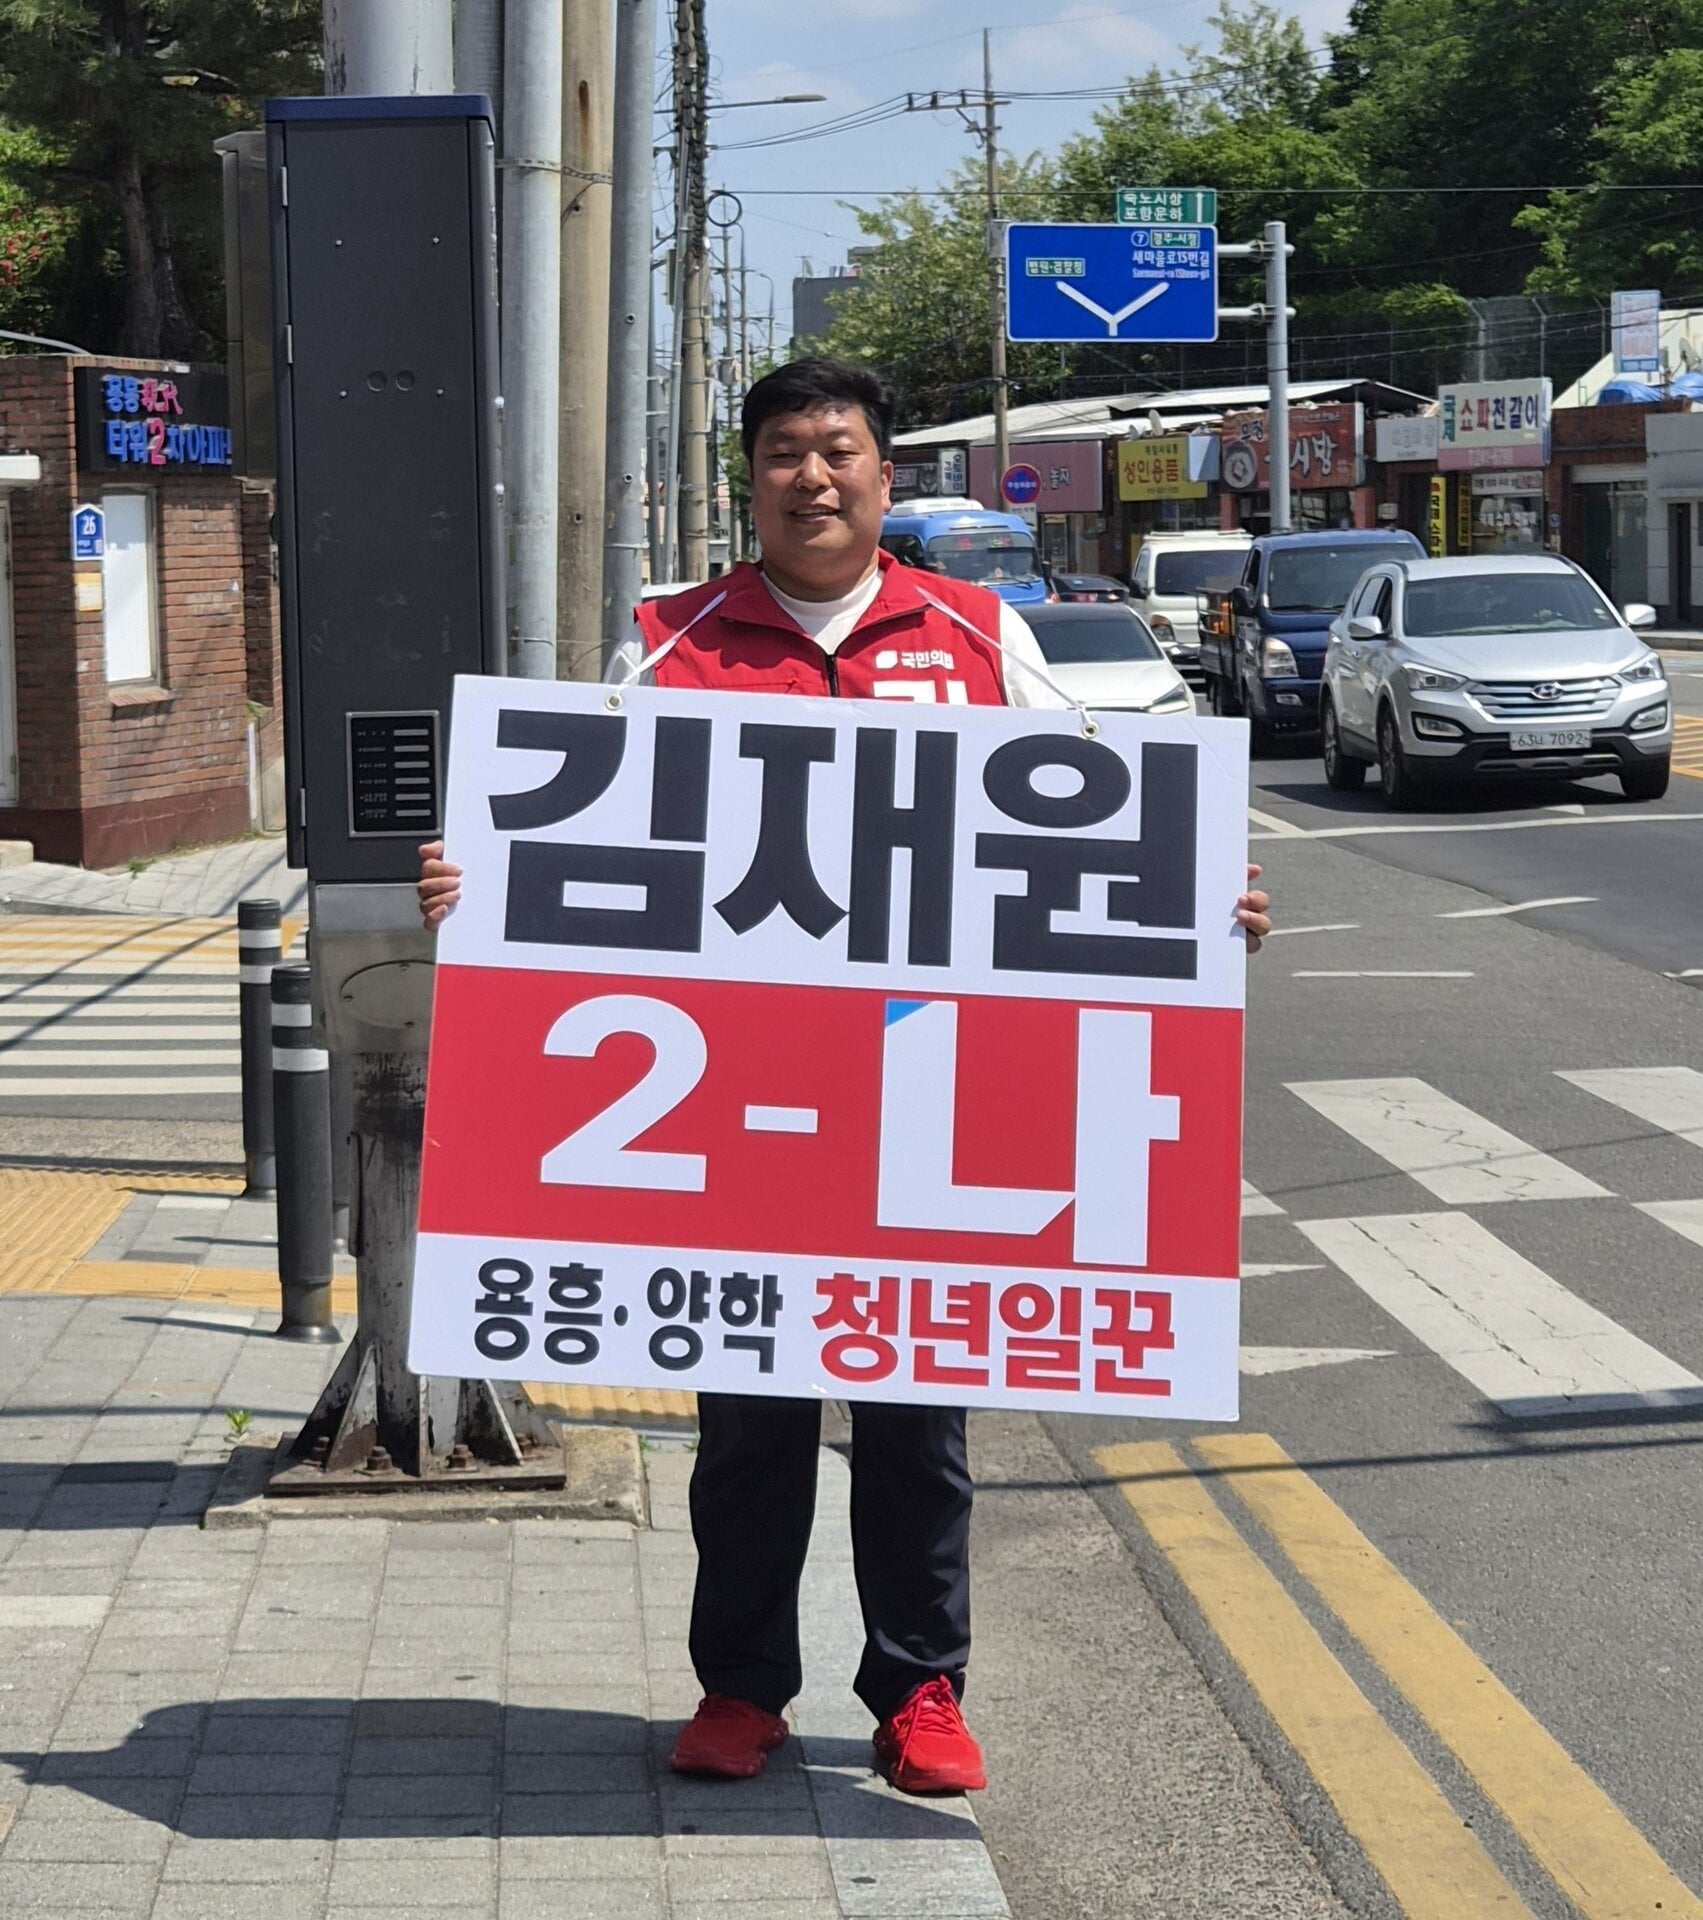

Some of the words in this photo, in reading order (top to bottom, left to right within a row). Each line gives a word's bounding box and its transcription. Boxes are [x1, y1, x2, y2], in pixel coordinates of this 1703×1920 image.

[1442, 394, 1456, 442] 국제
[1124, 458, 1179, 485] 성인용품
[81, 515, 97, 536] 26
[1549, 732, 1583, 746] 7092
[488, 708, 1200, 980] 김재원
[810, 1271, 1176, 1398] 청년일꾼
